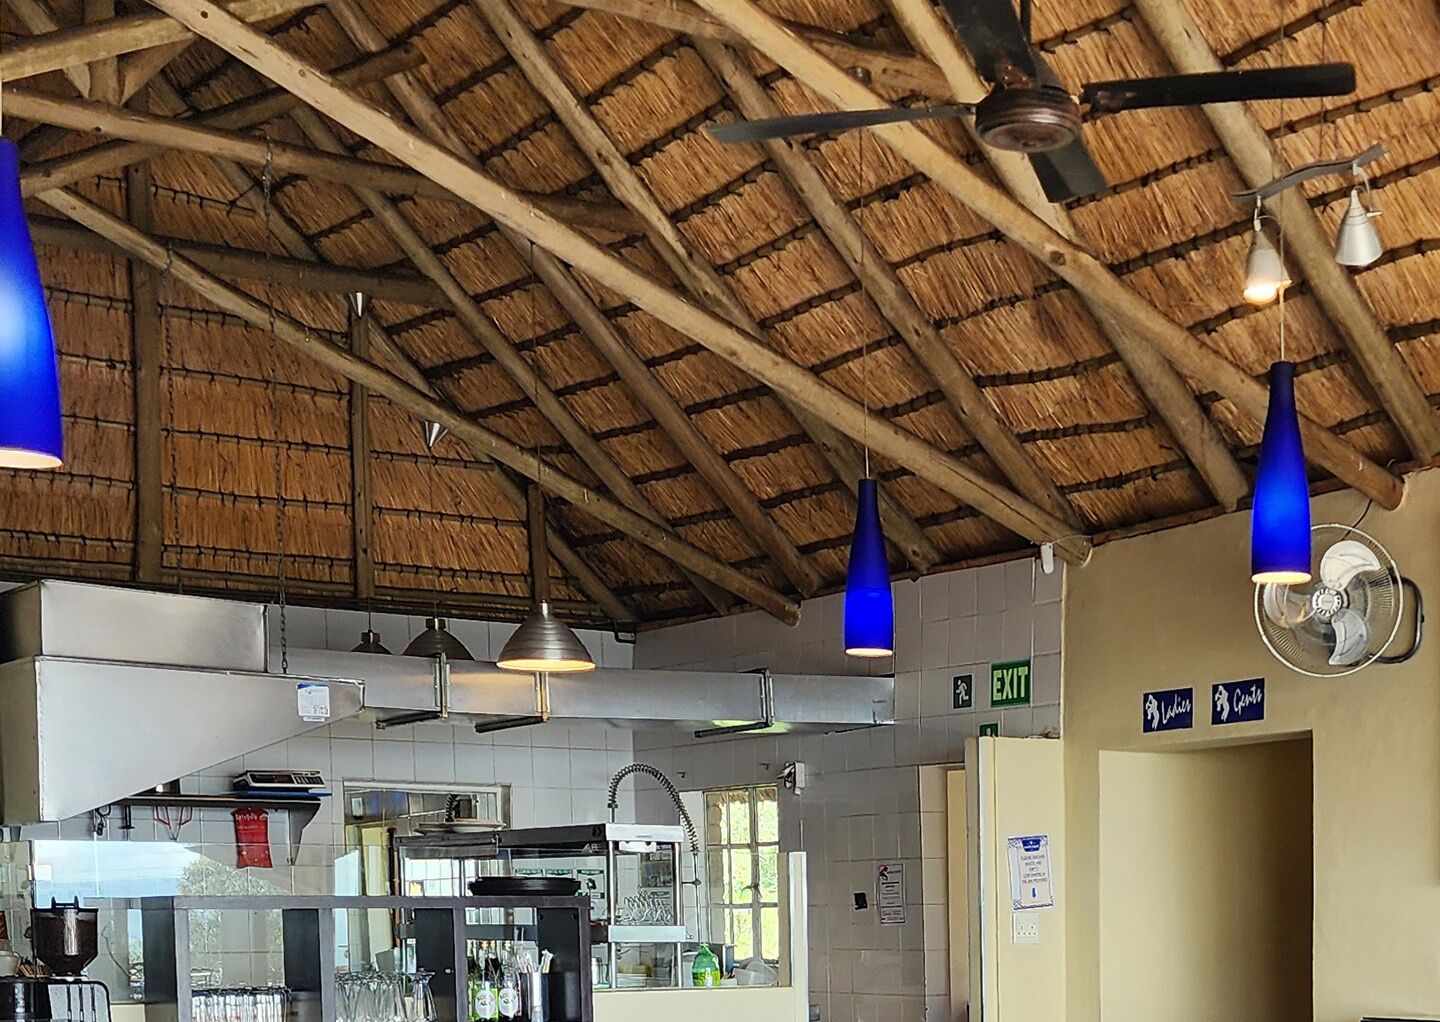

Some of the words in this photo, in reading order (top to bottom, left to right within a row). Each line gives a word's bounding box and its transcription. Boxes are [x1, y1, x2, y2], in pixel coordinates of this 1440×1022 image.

[993, 666, 1028, 700] EXIT
[1233, 683, 1262, 715] Gents
[1161, 693, 1191, 725] Ladies
